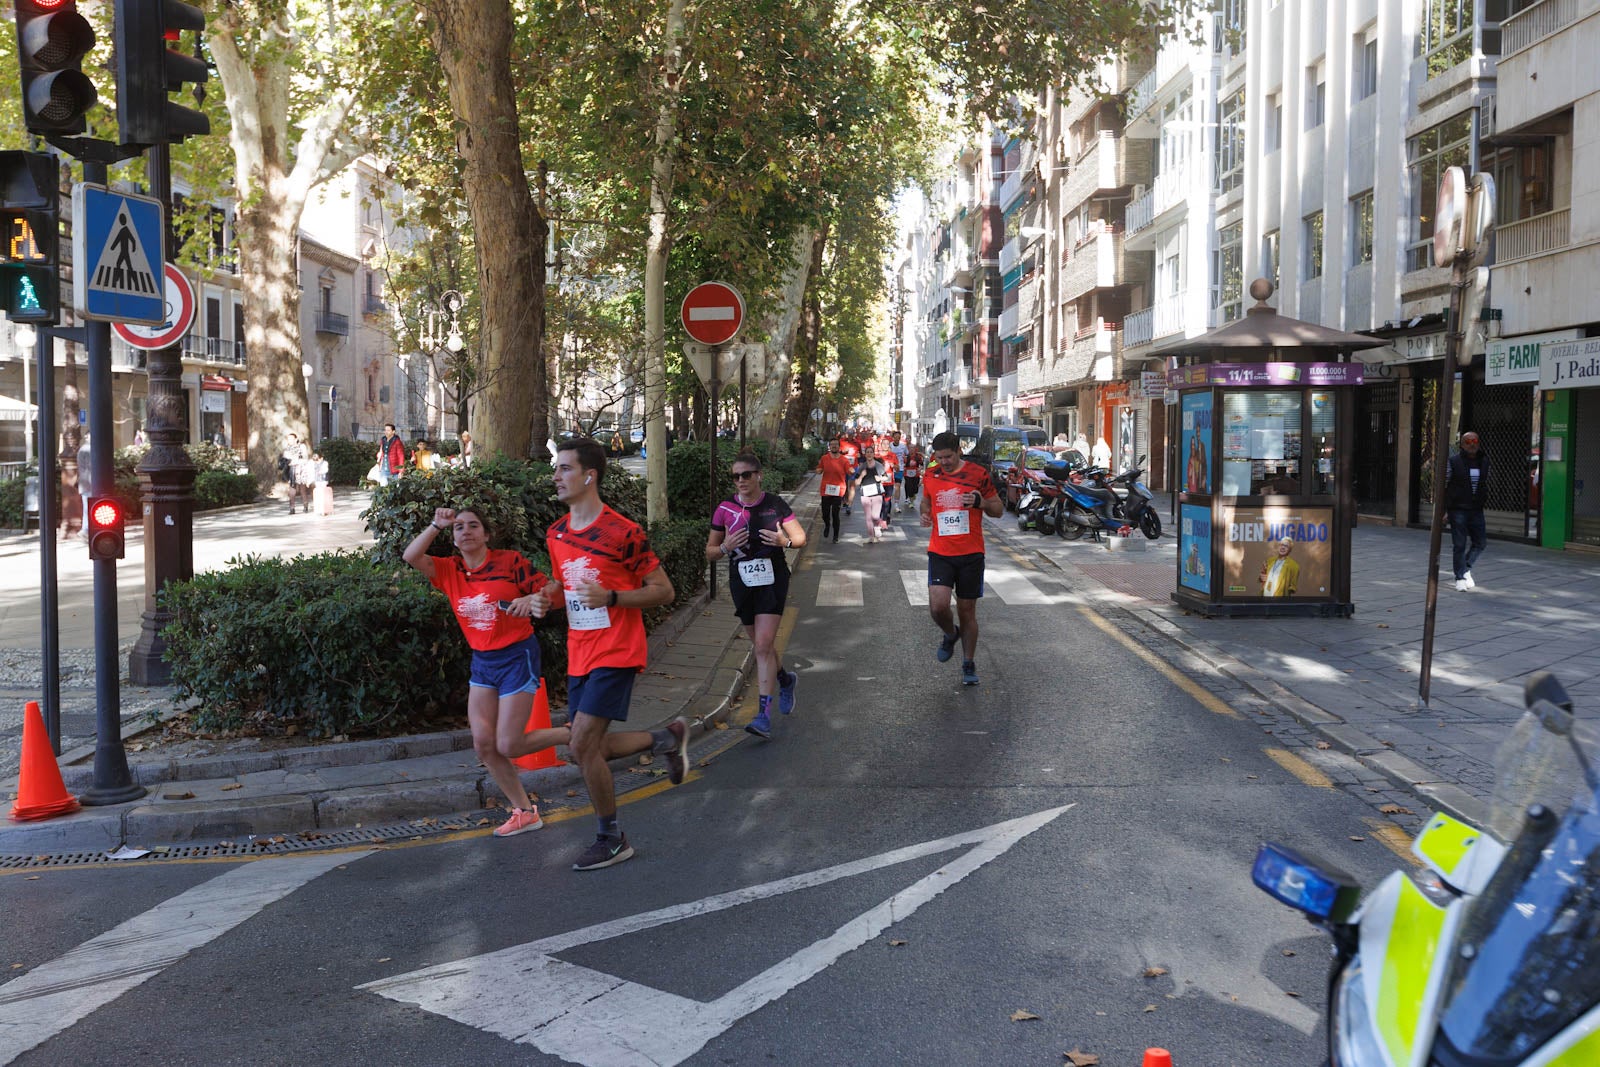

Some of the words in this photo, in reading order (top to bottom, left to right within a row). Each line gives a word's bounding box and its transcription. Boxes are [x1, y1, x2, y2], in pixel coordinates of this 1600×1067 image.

[1585, 341, 1600, 354] REL
[1228, 369, 1253, 382] 11/11
[944, 515, 961, 525] 564
[1229, 522, 1264, 542] BIEN
[1267, 522, 1329, 542] JUGADO
[743, 563, 766, 574] 1243
[568, 600, 596, 612] 16
